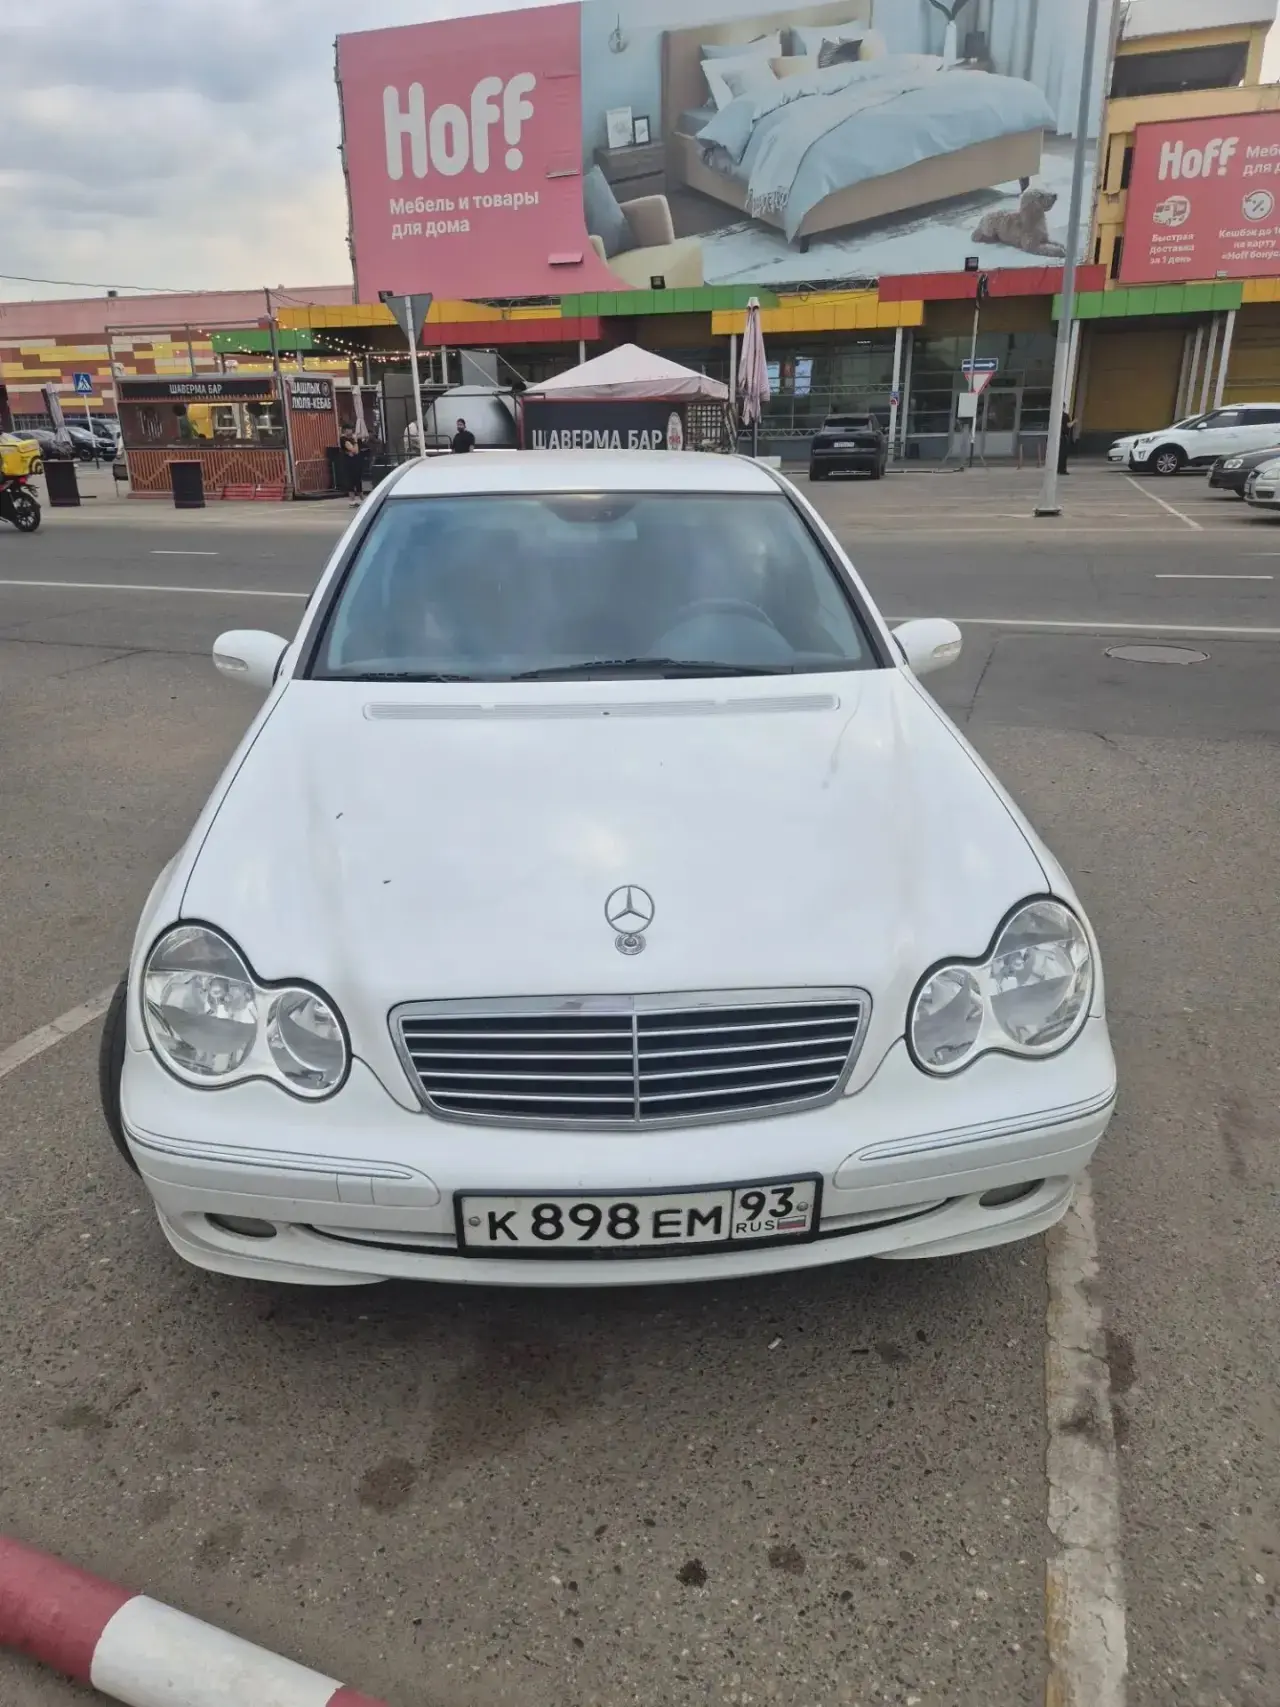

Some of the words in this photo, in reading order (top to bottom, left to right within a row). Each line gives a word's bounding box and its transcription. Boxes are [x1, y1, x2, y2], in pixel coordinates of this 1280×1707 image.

[1246, 143, 1280, 159] Меб
[1242, 163, 1272, 177] для
[390, 196, 455, 216] Мебель
[458, 197, 470, 211] и
[472, 190, 540, 210] товары
[391, 221, 422, 240] для
[425, 218, 470, 238] дома
[1151, 232, 1194, 243] Быстрая
[1246, 239, 1277, 249] карту
[1149, 244, 1195, 255] доставка
[1167, 256, 1192, 265] день
[169, 383, 207, 394] ШАВЕРМА
[208, 383, 223, 394] БАР
[291, 381, 320, 394] ШАШЛЫК
[292, 396, 332, 409] ЛЮЛЯ-КЕБАБ
[532, 429, 622, 450] ШАВЕРМА
[627, 428, 663, 450] БАР
[739, 1186, 795, 1221] 93
[735, 1219, 776, 1234] RUS
